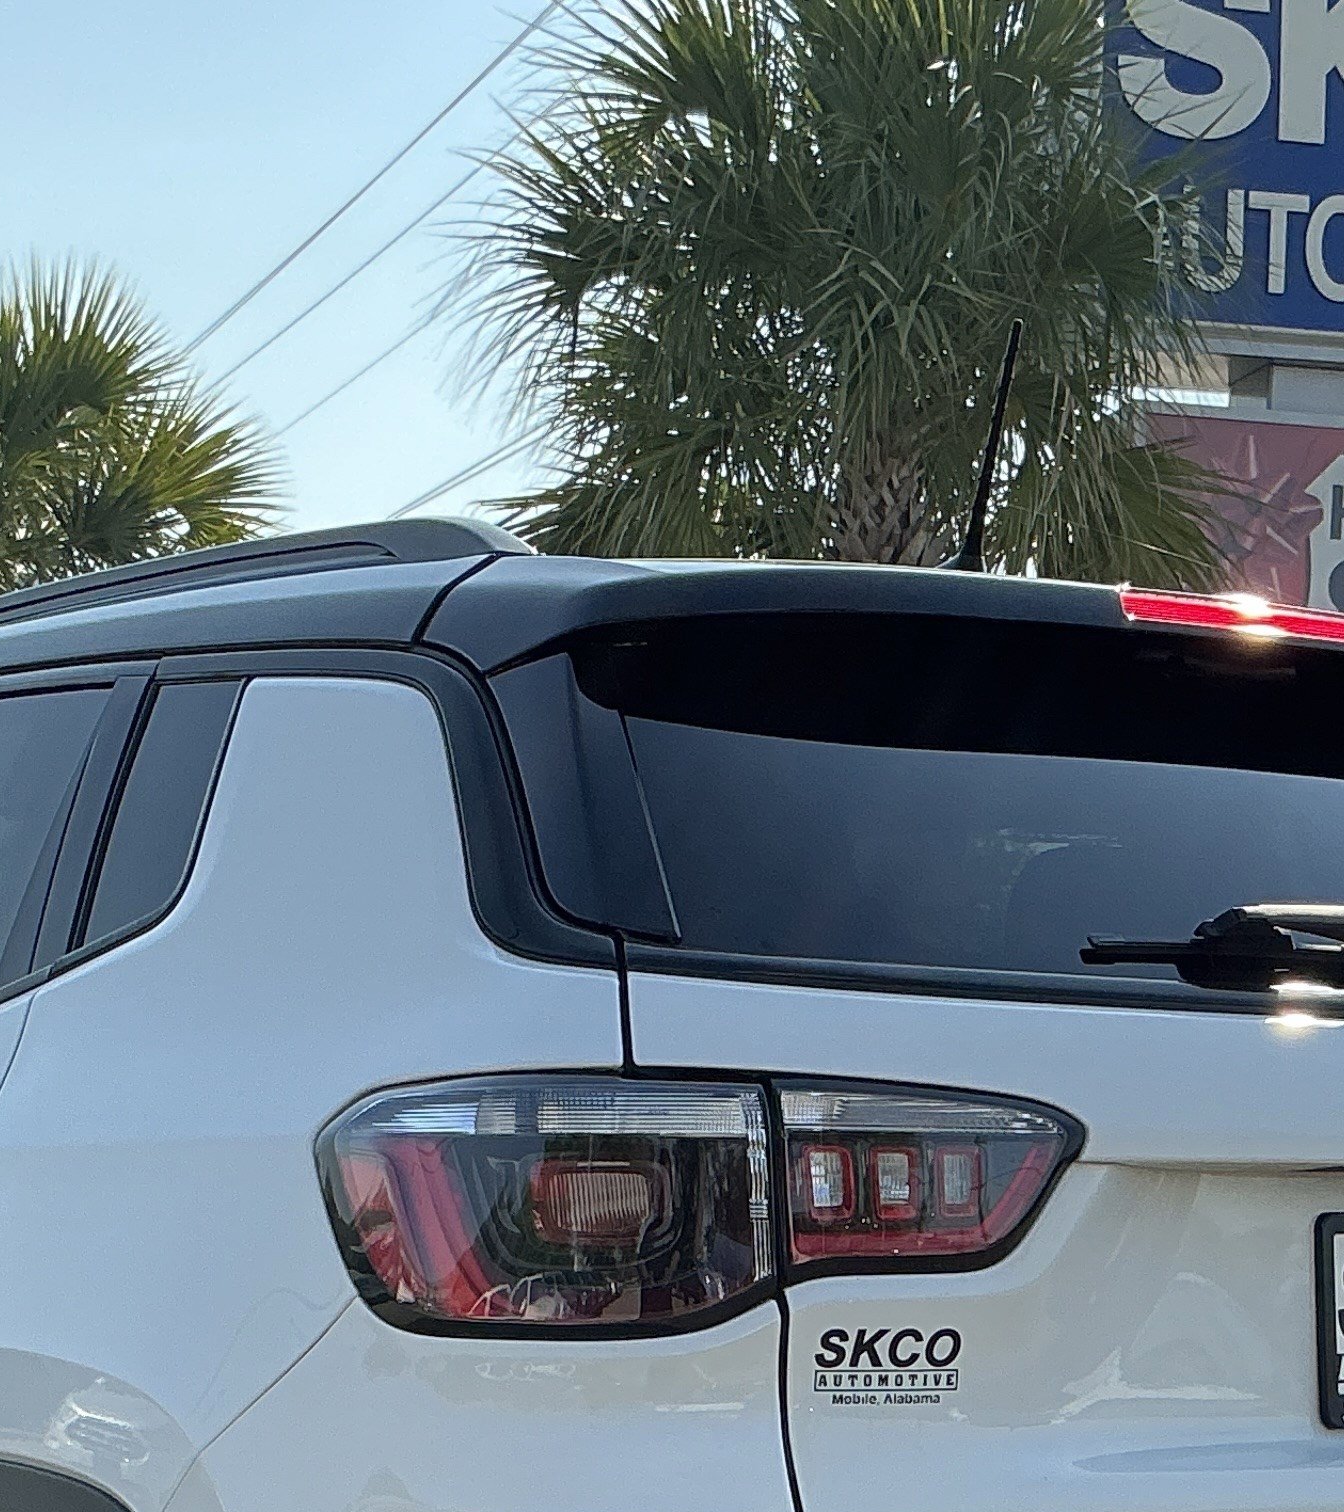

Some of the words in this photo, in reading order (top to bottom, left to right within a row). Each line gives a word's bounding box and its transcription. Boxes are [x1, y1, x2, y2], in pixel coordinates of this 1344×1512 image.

[814, 1328, 962, 1368] SKCO
[818, 1373, 955, 1387] AUTOMOTIVE
[832, 1394, 880, 1406] Mobile,
[883, 1393, 941, 1404] Alabama
